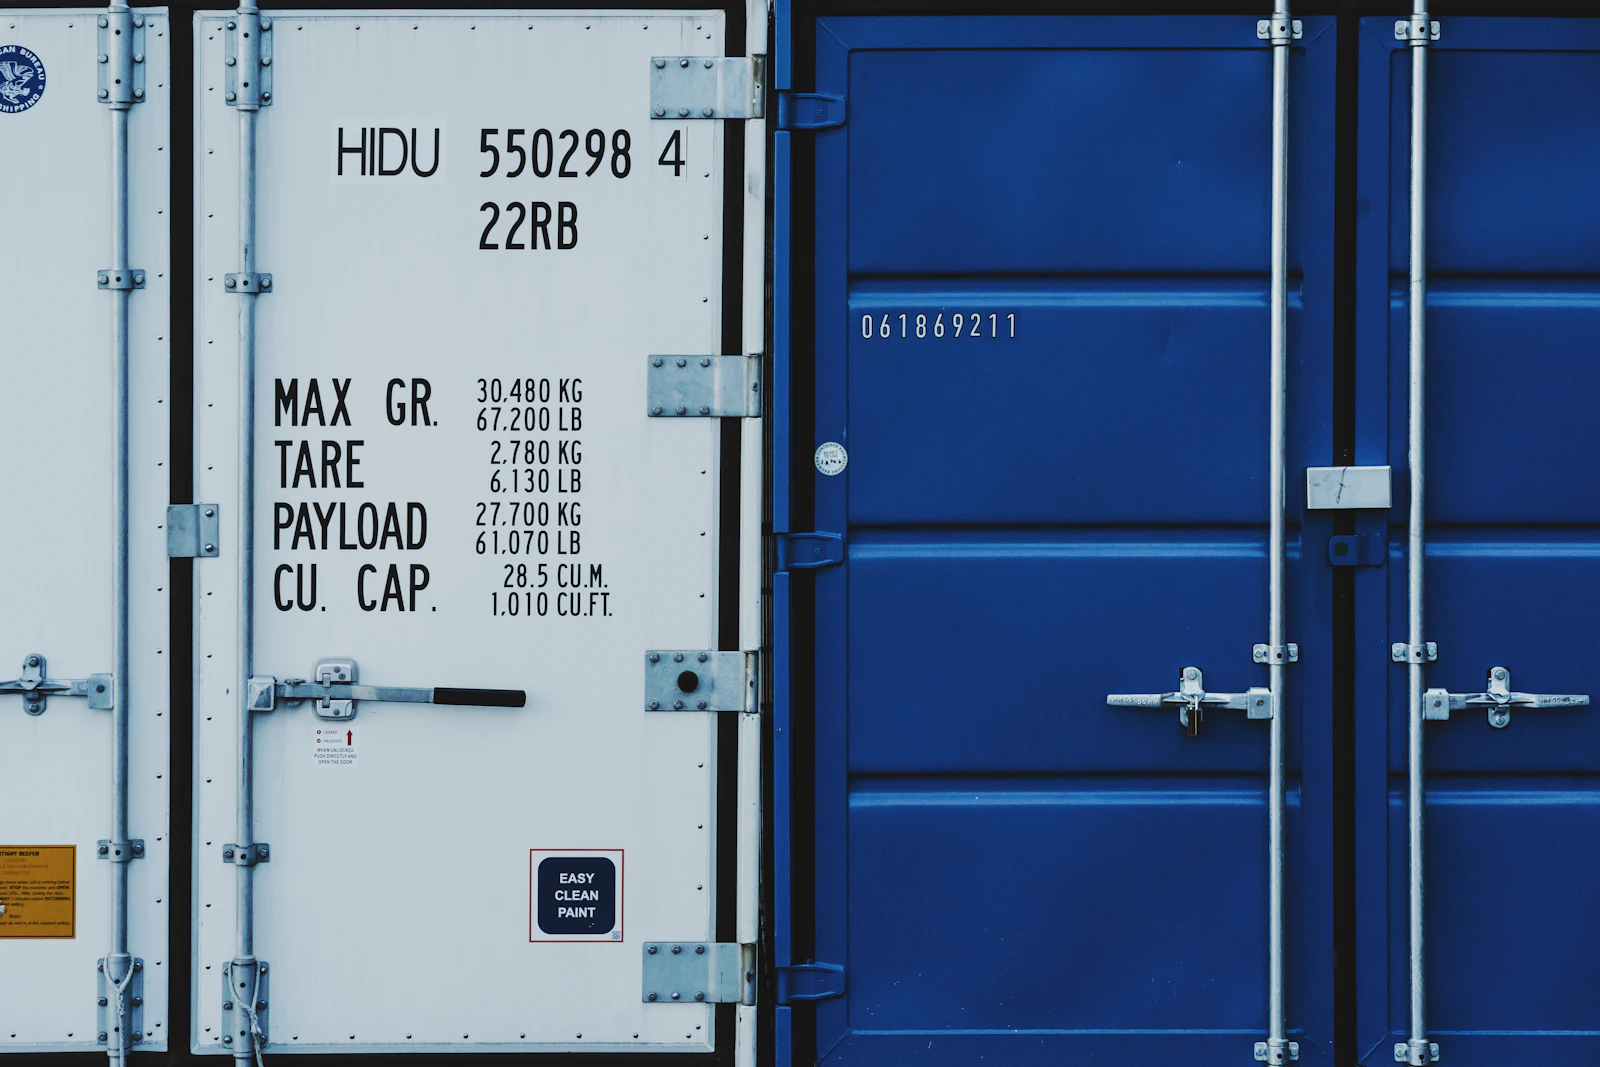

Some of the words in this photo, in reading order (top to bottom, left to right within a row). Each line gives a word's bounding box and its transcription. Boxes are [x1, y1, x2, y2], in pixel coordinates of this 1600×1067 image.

[19, 48, 45, 80] BUREAU
[337, 127, 440, 178] HIDU
[479, 128, 632, 179] 550298
[658, 129, 686, 177] 4
[478, 201, 578, 250] 22RB
[861, 313, 1019, 339] 061869211
[274, 378, 352, 427] MAX
[385, 377, 438, 427] GR.
[476, 378, 550, 403] 30,480
[559, 378, 583, 403] KG
[476, 406, 550, 432] 67,200
[559, 406, 582, 432] LB
[274, 440, 365, 489] TARE
[490, 440, 550, 465] 2,780
[558, 440, 582, 465] KG
[490, 468, 550, 494] 6,130
[558, 468, 582, 493] LB
[273, 501, 428, 551] PAYLOAD
[475, 501, 549, 527] 27,700
[558, 501, 581, 527] KG
[475, 529, 549, 555] 61,070
[557, 530, 581, 555] LB
[273, 563, 326, 612] CU.
[357, 563, 437, 612] CAP.
[503, 563, 548, 588] 28.5
[557, 563, 608, 588] CU.M.
[491, 591, 548, 617] 1,010
[557, 591, 613, 617] CU.FT.
[559, 872, 595, 884] EASY
[554, 889, 599, 901] CLEAN
[557, 906, 597, 918] PAINT
